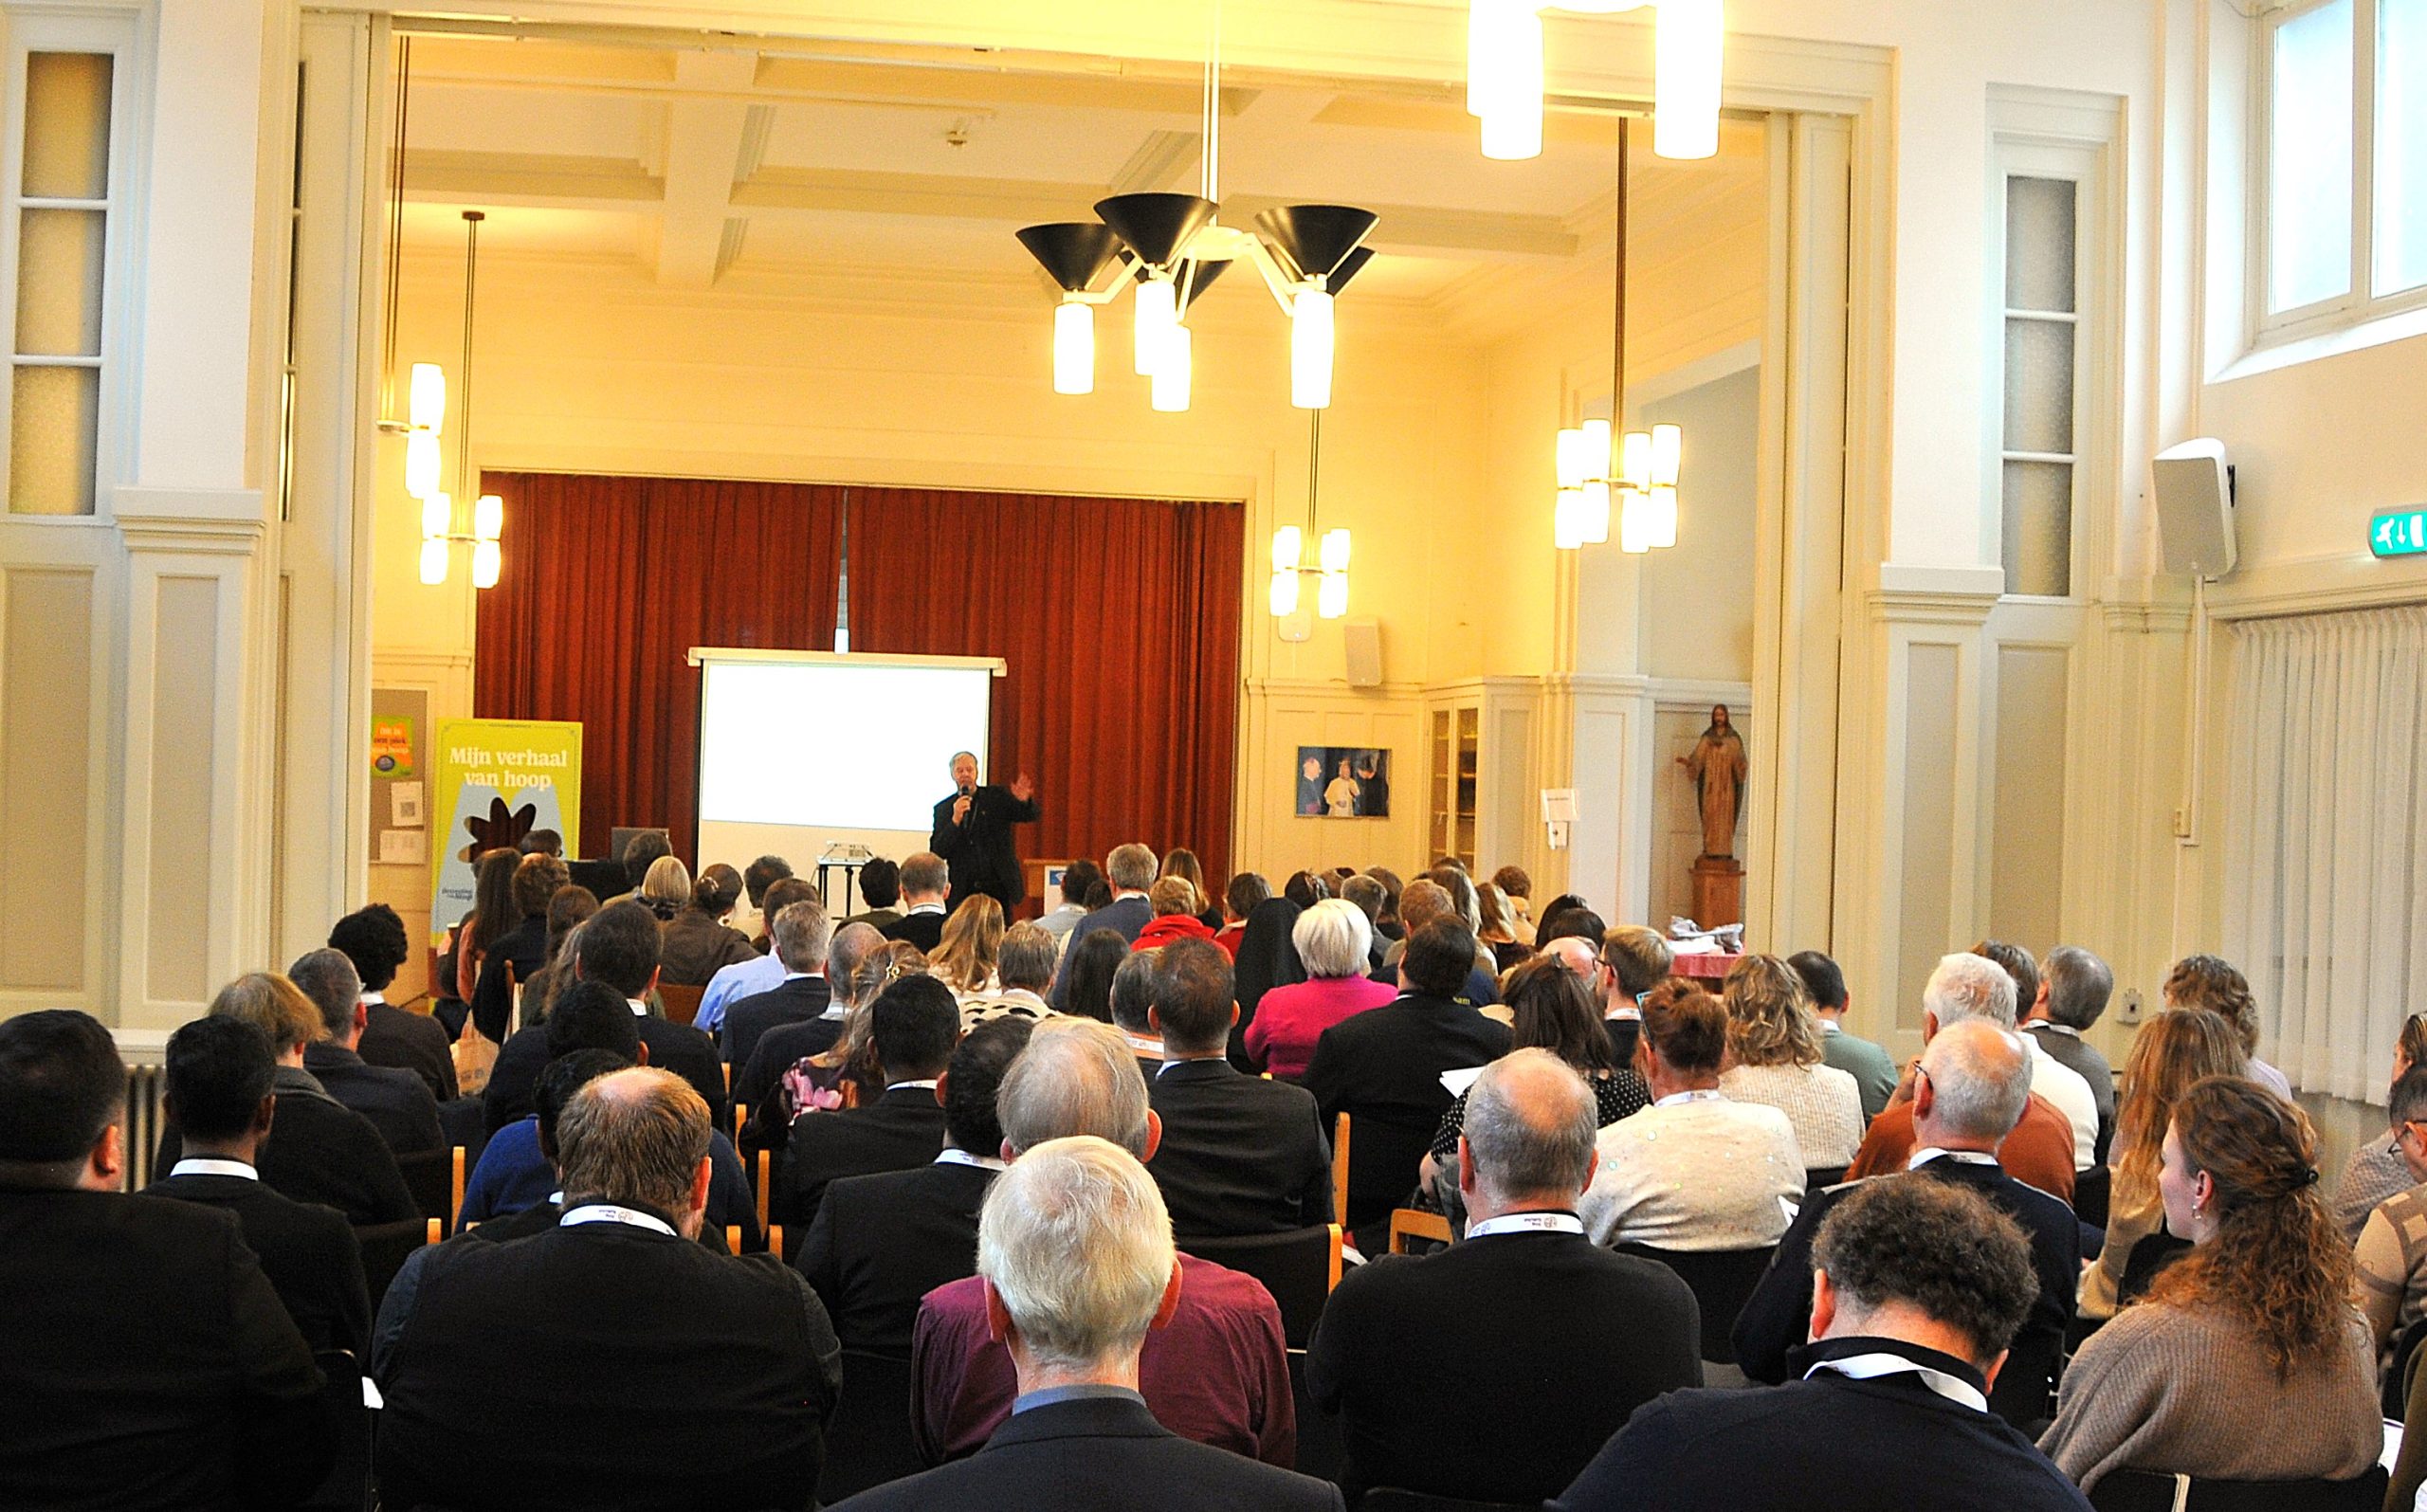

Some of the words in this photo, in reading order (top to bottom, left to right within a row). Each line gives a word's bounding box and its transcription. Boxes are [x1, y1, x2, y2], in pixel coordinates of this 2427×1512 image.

[449, 747, 491, 768] Mijn
[496, 749, 567, 767] verhaal
[464, 773, 499, 786] van
[503, 770, 551, 791] hoop
